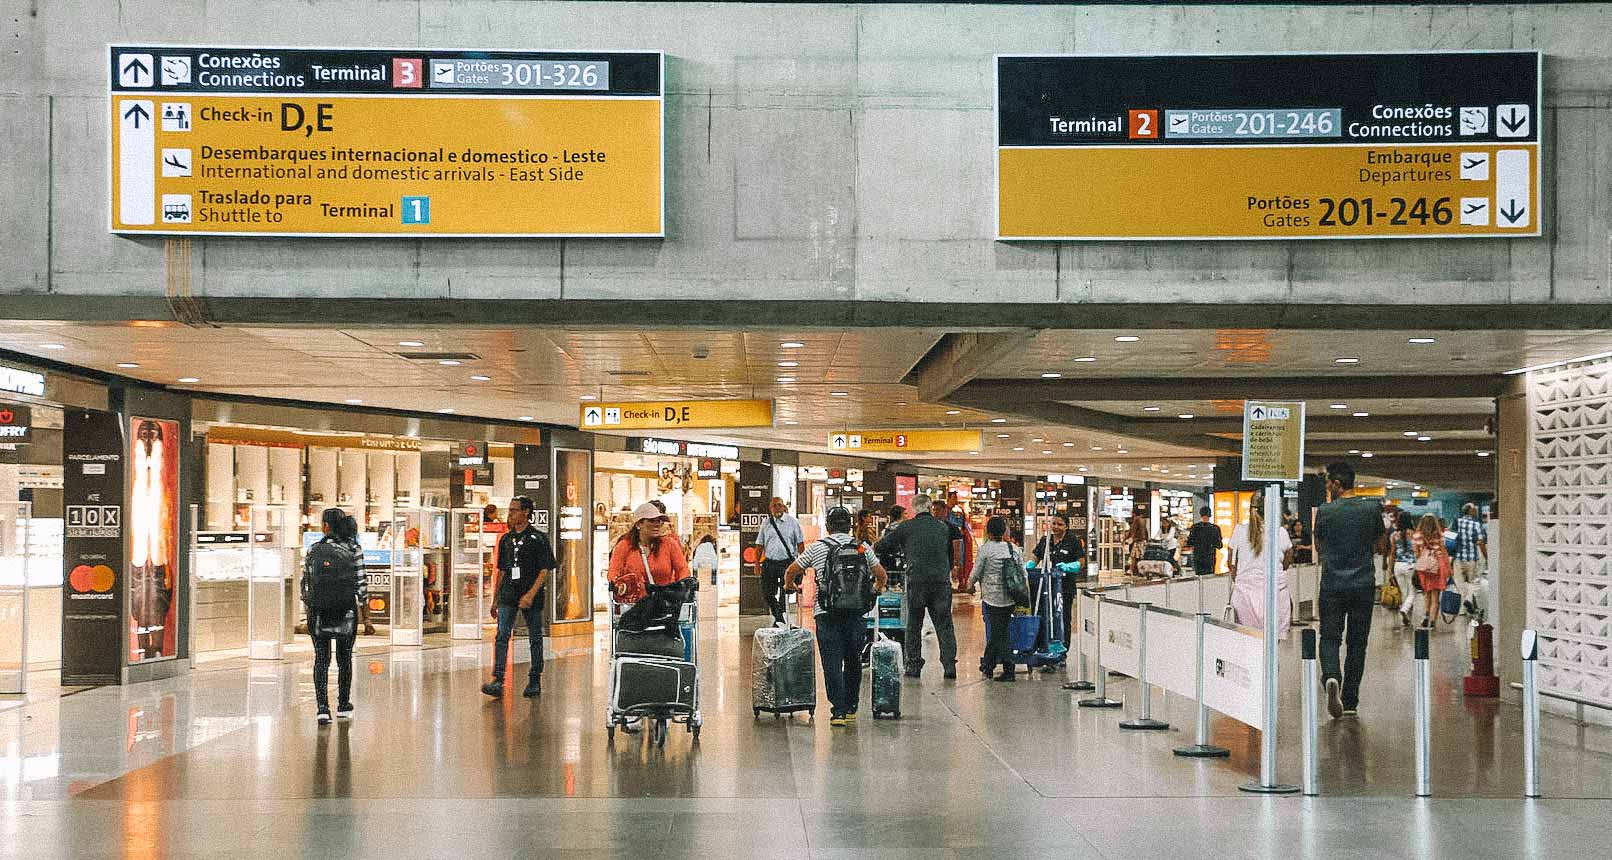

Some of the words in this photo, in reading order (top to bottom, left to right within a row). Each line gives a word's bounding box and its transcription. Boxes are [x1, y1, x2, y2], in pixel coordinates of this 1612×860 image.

[199, 53, 281, 69] Conexões
[457, 62, 500, 73] Portões
[199, 72, 304, 87] Connections
[311, 65, 386, 81] Terminal
[400, 61, 414, 84] 3
[457, 74, 489, 85] Gates
[501, 63, 598, 86] 301-326
[1192, 112, 1233, 122] Portões
[1372, 104, 1452, 119] Conexões
[200, 107, 273, 123] Check-in
[281, 103, 334, 137] D,E
[1049, 116, 1122, 133] Terminal
[1137, 113, 1152, 135] 2
[1235, 112, 1333, 135] 201-246
[1192, 123, 1224, 134] Gates
[1349, 123, 1452, 137] Connections
[201, 146, 327, 167] Desembarques
[331, 146, 443, 163] internacional
[448, 152, 457, 163] e
[462, 148, 548, 164] domestico
[563, 149, 606, 163] Leste
[1367, 150, 1452, 167] Embarque
[201, 164, 313, 179] International
[316, 165, 347, 179] and
[352, 165, 429, 180] domestic
[433, 167, 495, 181] arrivals
[510, 167, 544, 182] East
[549, 167, 584, 181] Side
[1359, 168, 1452, 185] Departures
[199, 190, 270, 205] Traslado
[275, 194, 312, 208] para
[1247, 196, 1310, 210] Portões
[199, 208, 263, 223] Shuttle
[266, 210, 283, 223] to
[320, 203, 394, 218] Terminal
[410, 199, 422, 222] 1
[1318, 197, 1453, 226] 201-246
[1263, 214, 1310, 227] Gates
[623, 410, 660, 419] Check-in
[664, 406, 690, 424] D,E
[863, 436, 894, 445] Terminal
[897, 435, 906, 447] 3
[70, 509, 117, 525] 10X
